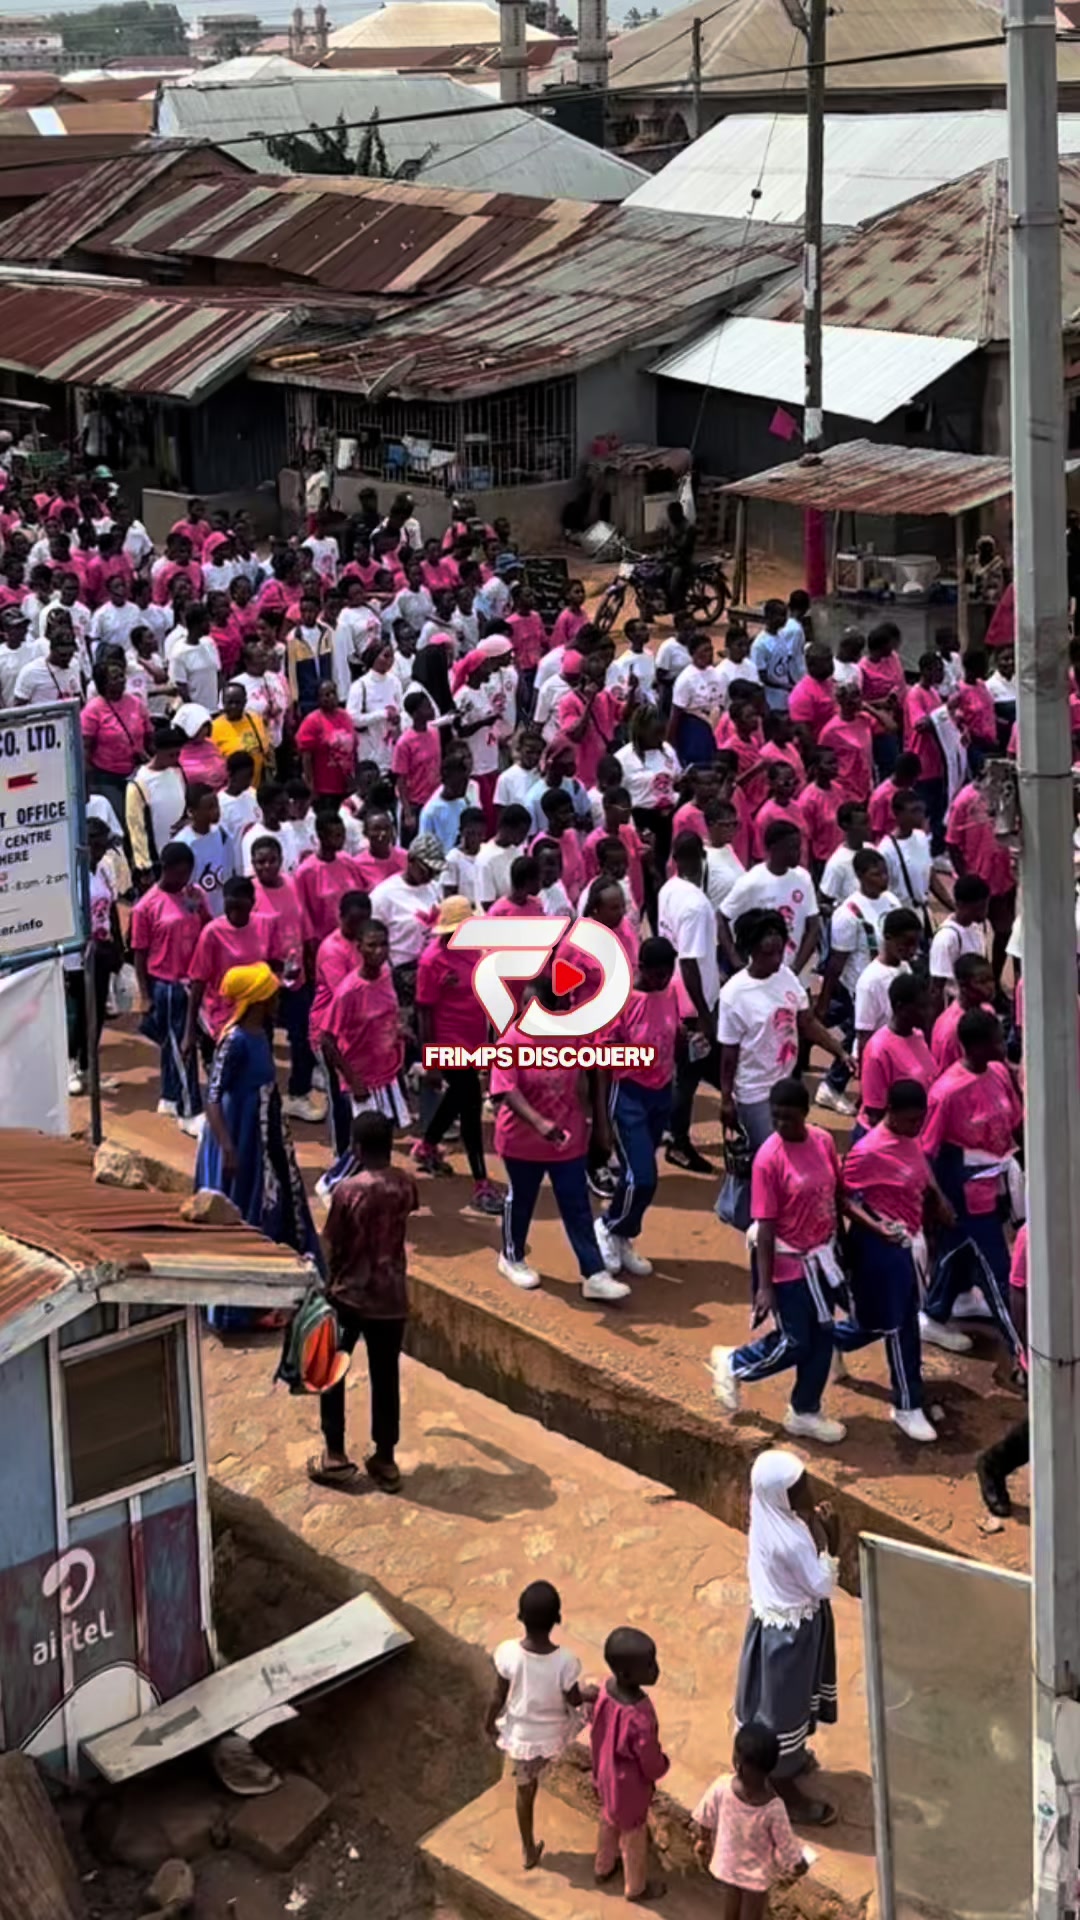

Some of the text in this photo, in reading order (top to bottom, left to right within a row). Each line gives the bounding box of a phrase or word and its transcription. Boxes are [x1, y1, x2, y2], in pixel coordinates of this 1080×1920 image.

[0, 724, 61, 757] O. LTD.
[17, 801, 66, 824] OFFICE
[5, 829, 52, 848] CENTRE
[0, 919, 44, 937] er.info
[33, 1609, 114, 1666] airtel
